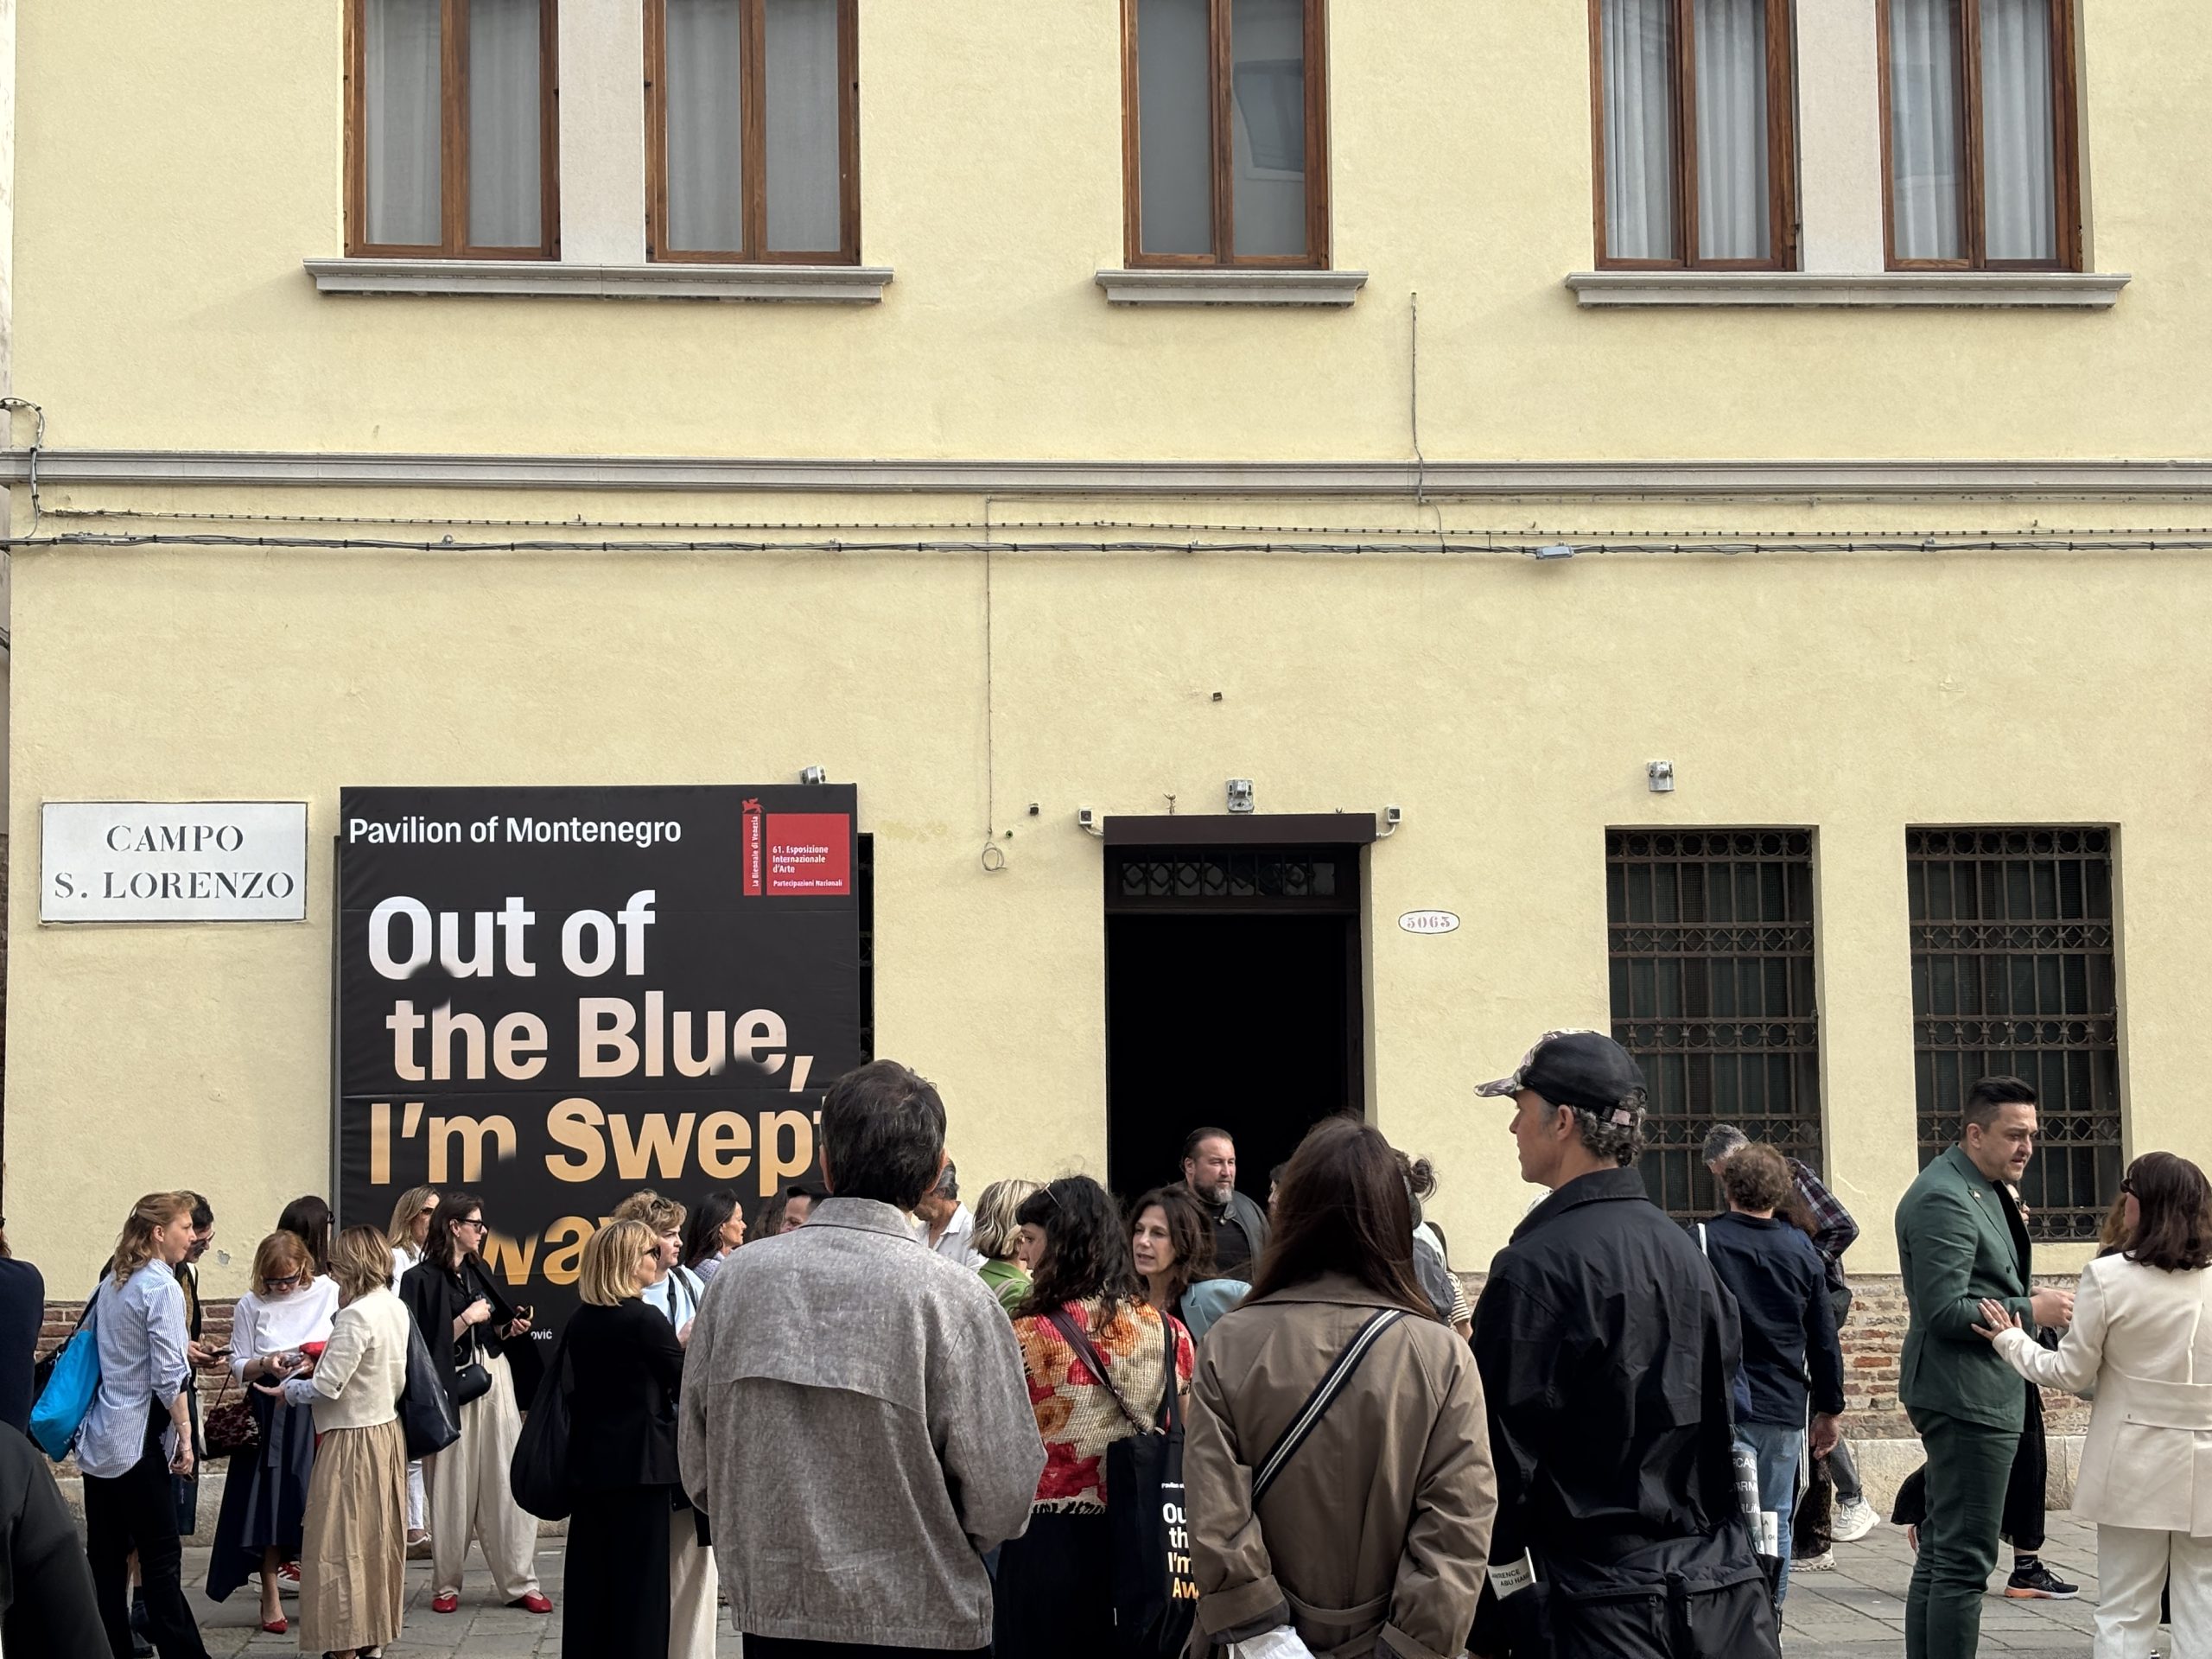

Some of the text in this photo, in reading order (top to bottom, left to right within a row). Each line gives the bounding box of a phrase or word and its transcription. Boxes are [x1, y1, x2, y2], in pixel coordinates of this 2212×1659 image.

[106, 824, 244, 852] CAMPO
[349, 815, 682, 849] Pavilion of Montenegro
[772, 855, 826, 863] Internazionale
[786, 844, 829, 855] Esposizione
[772, 864, 796, 874] d'Arte
[54, 872, 295, 899] S. LORENZO
[773, 879, 843, 888] Partecipazioni Nazionali
[368, 889, 656, 981] Out of
[385, 990, 814, 1093] the Blue,
[370, 1097, 827, 1198] I'm Swep
[1162, 1503, 1187, 1524] Ou
[1168, 1526, 1190, 1548] th
